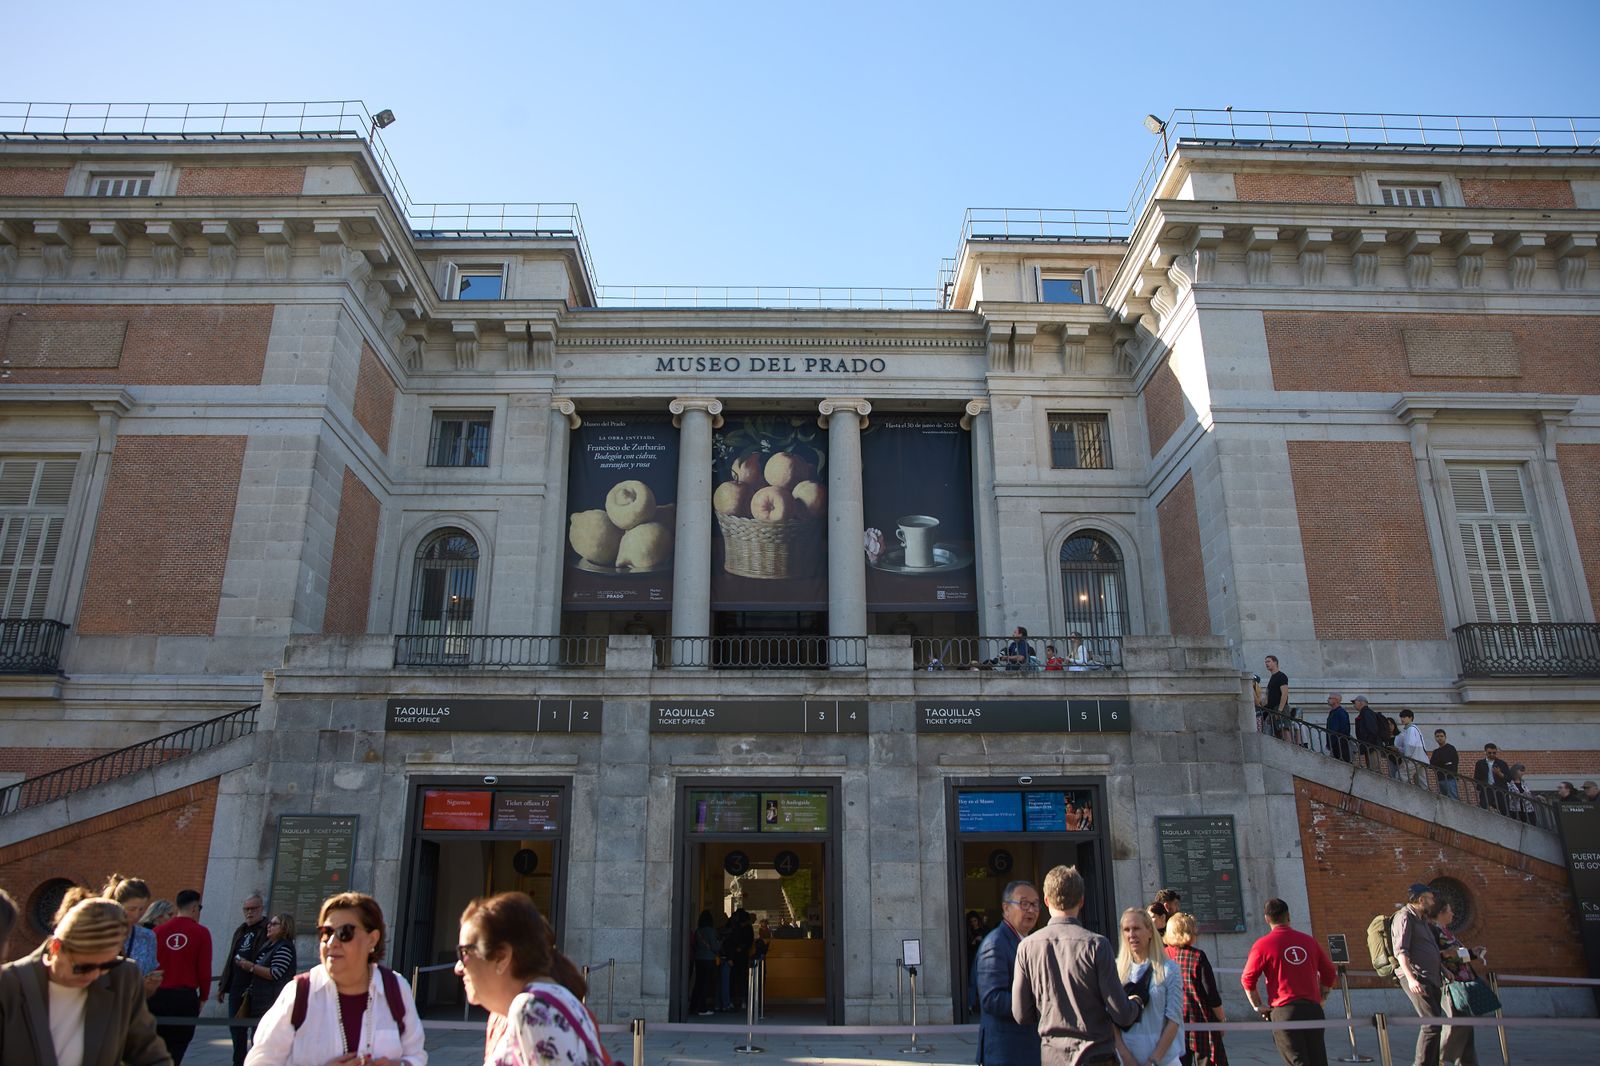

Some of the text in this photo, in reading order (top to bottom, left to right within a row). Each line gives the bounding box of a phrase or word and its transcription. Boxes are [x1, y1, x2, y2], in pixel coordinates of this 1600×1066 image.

[655, 357, 886, 373] MUSEO DEL PRADO
[632, 443, 666, 451] Zurbarán
[594, 453, 622, 461] Bodegón
[600, 461, 629, 470] naranjas
[395, 706, 450, 716] TAQUILLAS
[552, 711, 557, 719] 1
[582, 711, 589, 720] 2
[658, 708, 715, 717] TAQUILLAS
[925, 708, 981, 717] TAQUILLAS
[818, 712, 825, 720] 3
[850, 712, 857, 720] 4
[1081, 712, 1087, 720] 5
[1111, 712, 1118, 720] 6
[731, 855, 742, 871] 3
[780, 855, 793, 871] 4
[994, 853, 1007, 870] 6
